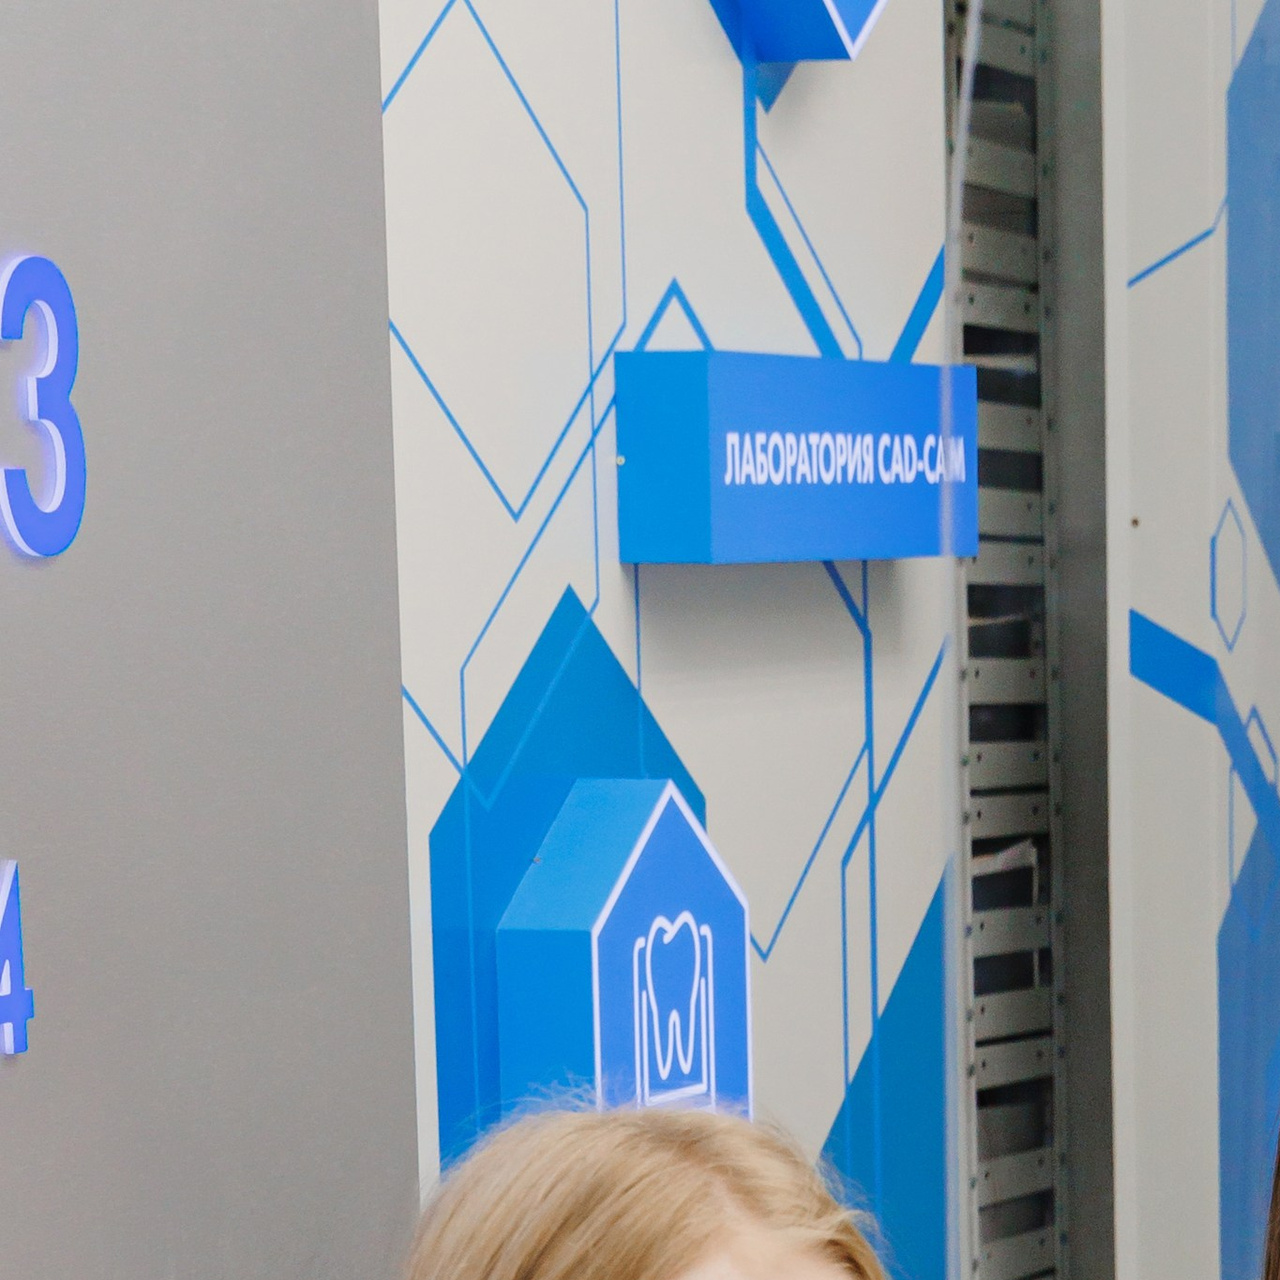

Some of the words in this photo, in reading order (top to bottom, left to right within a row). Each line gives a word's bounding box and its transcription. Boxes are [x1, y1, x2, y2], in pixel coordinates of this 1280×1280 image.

[0, 255, 86, 557] 3
[725, 432, 874, 485] ЛАБОРАТОРИЯ
[878, 433, 966, 485] CAD-CAM
